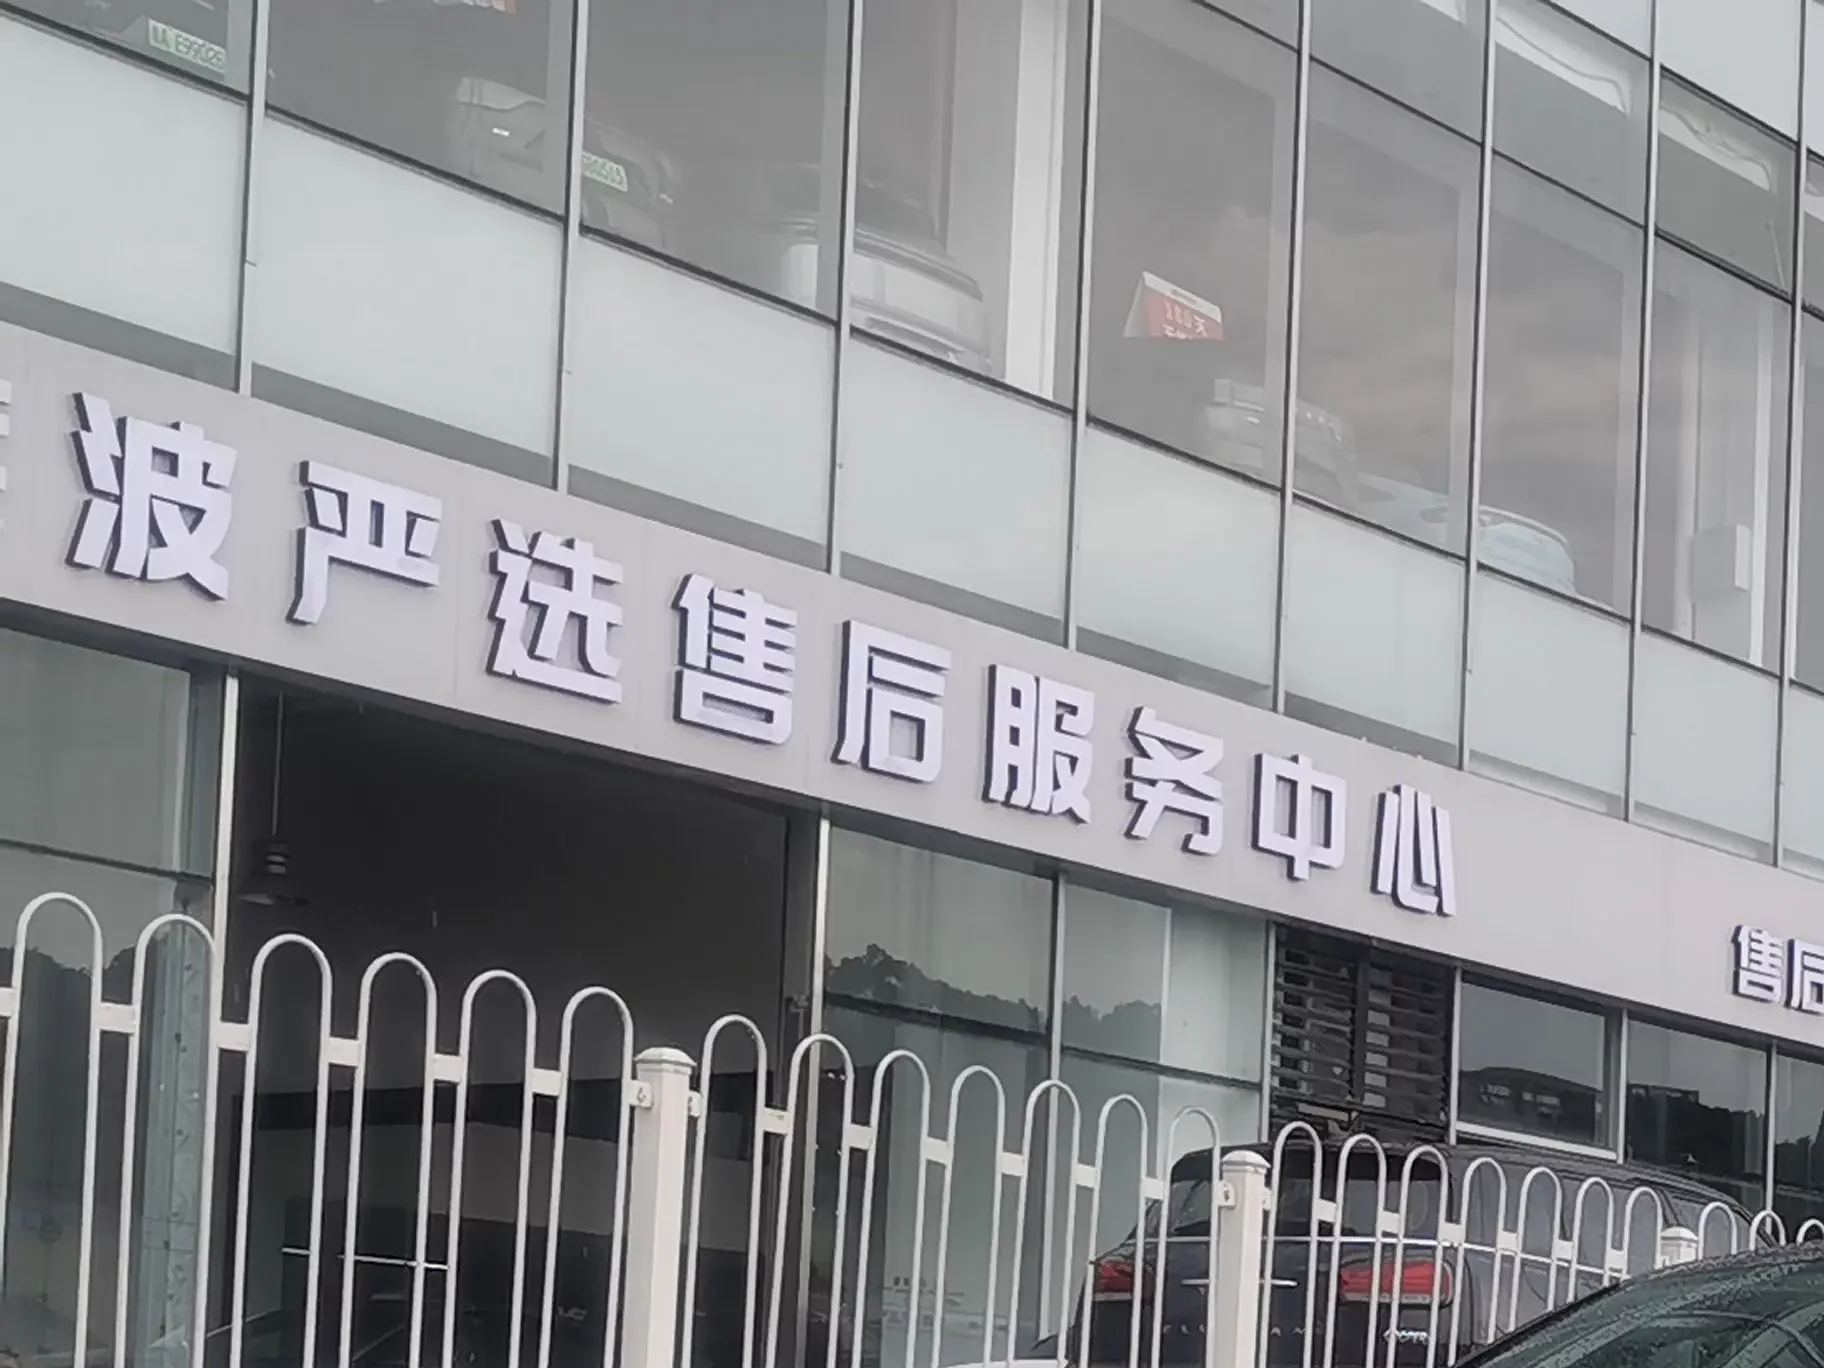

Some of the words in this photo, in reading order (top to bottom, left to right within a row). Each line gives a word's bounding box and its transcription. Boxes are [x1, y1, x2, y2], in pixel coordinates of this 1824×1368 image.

[0, 380, 1457, 917] 波严选售后服务中心
